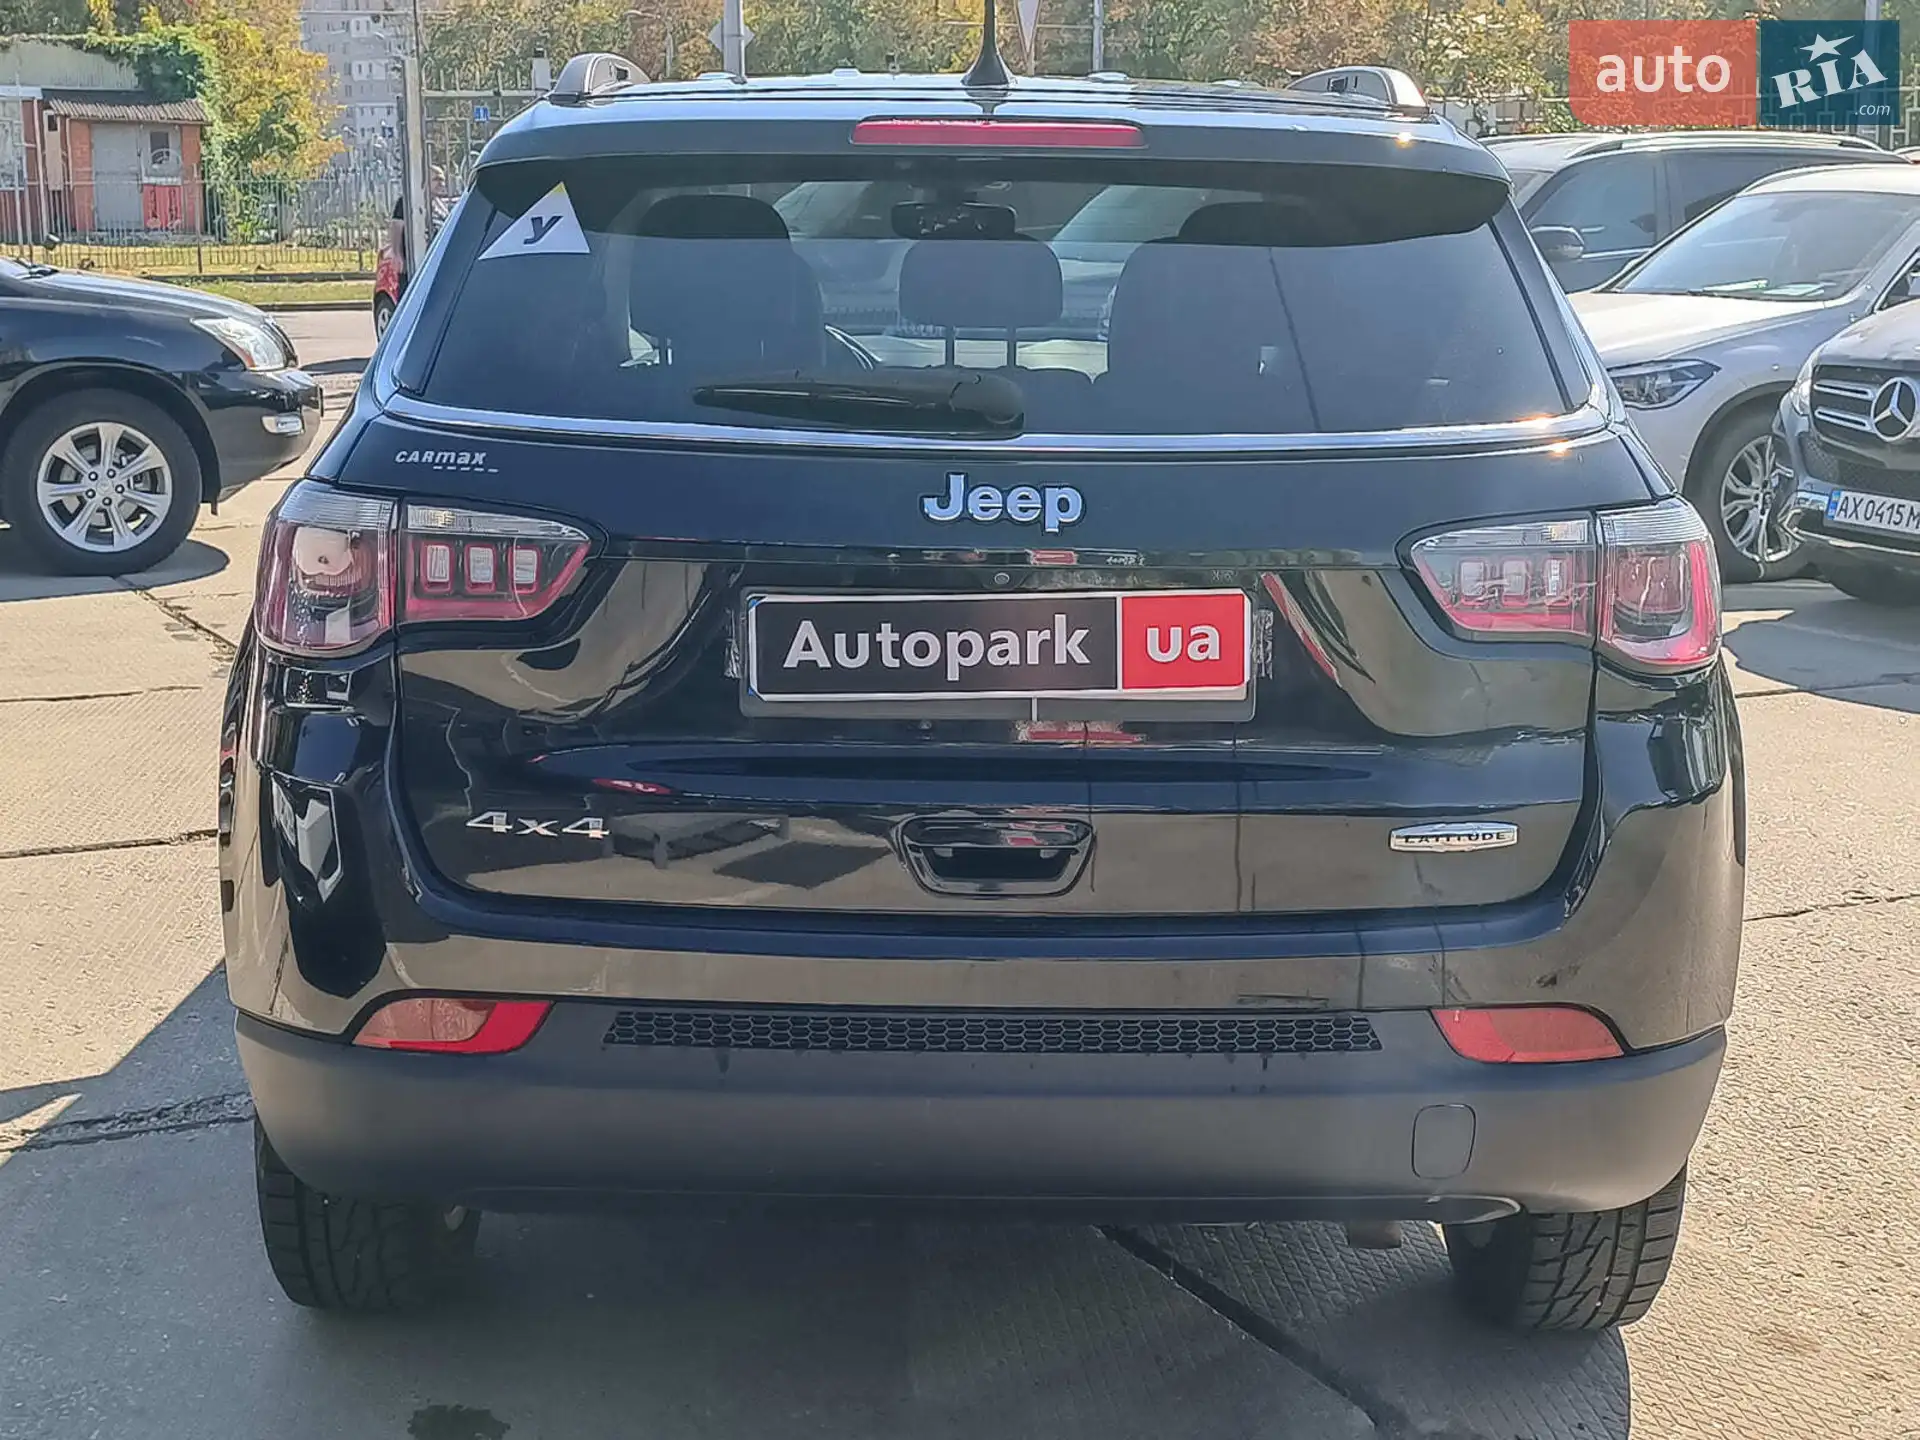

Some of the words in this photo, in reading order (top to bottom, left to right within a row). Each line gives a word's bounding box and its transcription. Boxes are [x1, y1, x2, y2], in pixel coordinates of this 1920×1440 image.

[923, 474, 1083, 533] Jeep
[783, 613, 1091, 681] Autopark
[1146, 623, 1221, 663] ua
